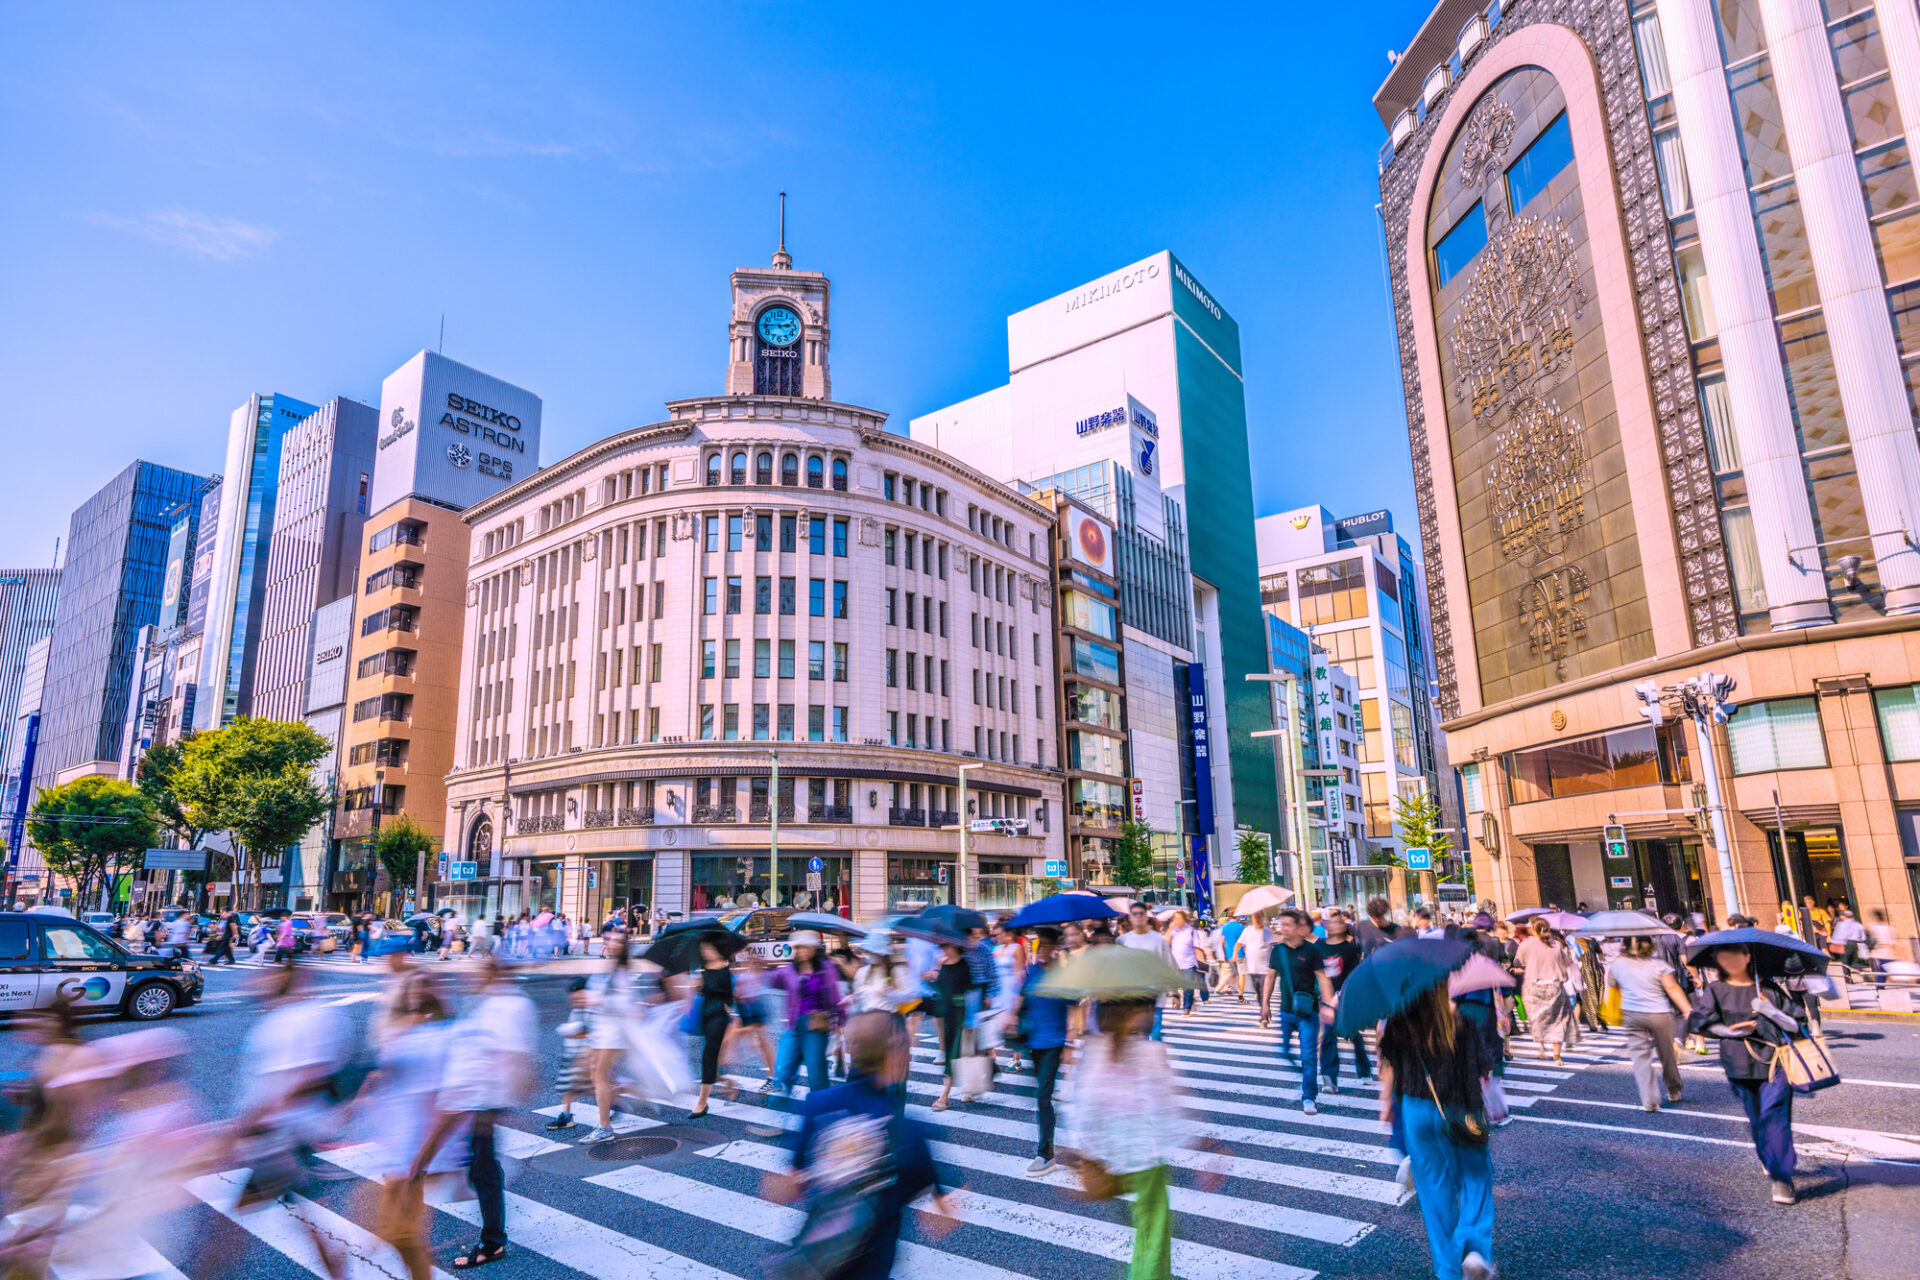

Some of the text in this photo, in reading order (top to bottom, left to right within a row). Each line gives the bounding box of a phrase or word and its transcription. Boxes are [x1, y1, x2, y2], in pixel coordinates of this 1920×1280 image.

[1065, 264, 1160, 313] MIKIMOTO
[1174, 263, 1221, 321] MIKIMOTO
[761, 349, 797, 358] SEIKO
[447, 392, 522, 432] SEIKO
[1076, 407, 1124, 435] 山野楽器
[440, 412, 525, 454] ASTRON
[478, 452, 513, 473] GPS
[478, 464, 512, 481] SOLAR
[1342, 511, 1386, 528] HUBLOT
[316, 645, 342, 664] SEIKO
[1315, 666, 1332, 731] 教文館
[1192, 695, 1207, 758] 山野楽器
